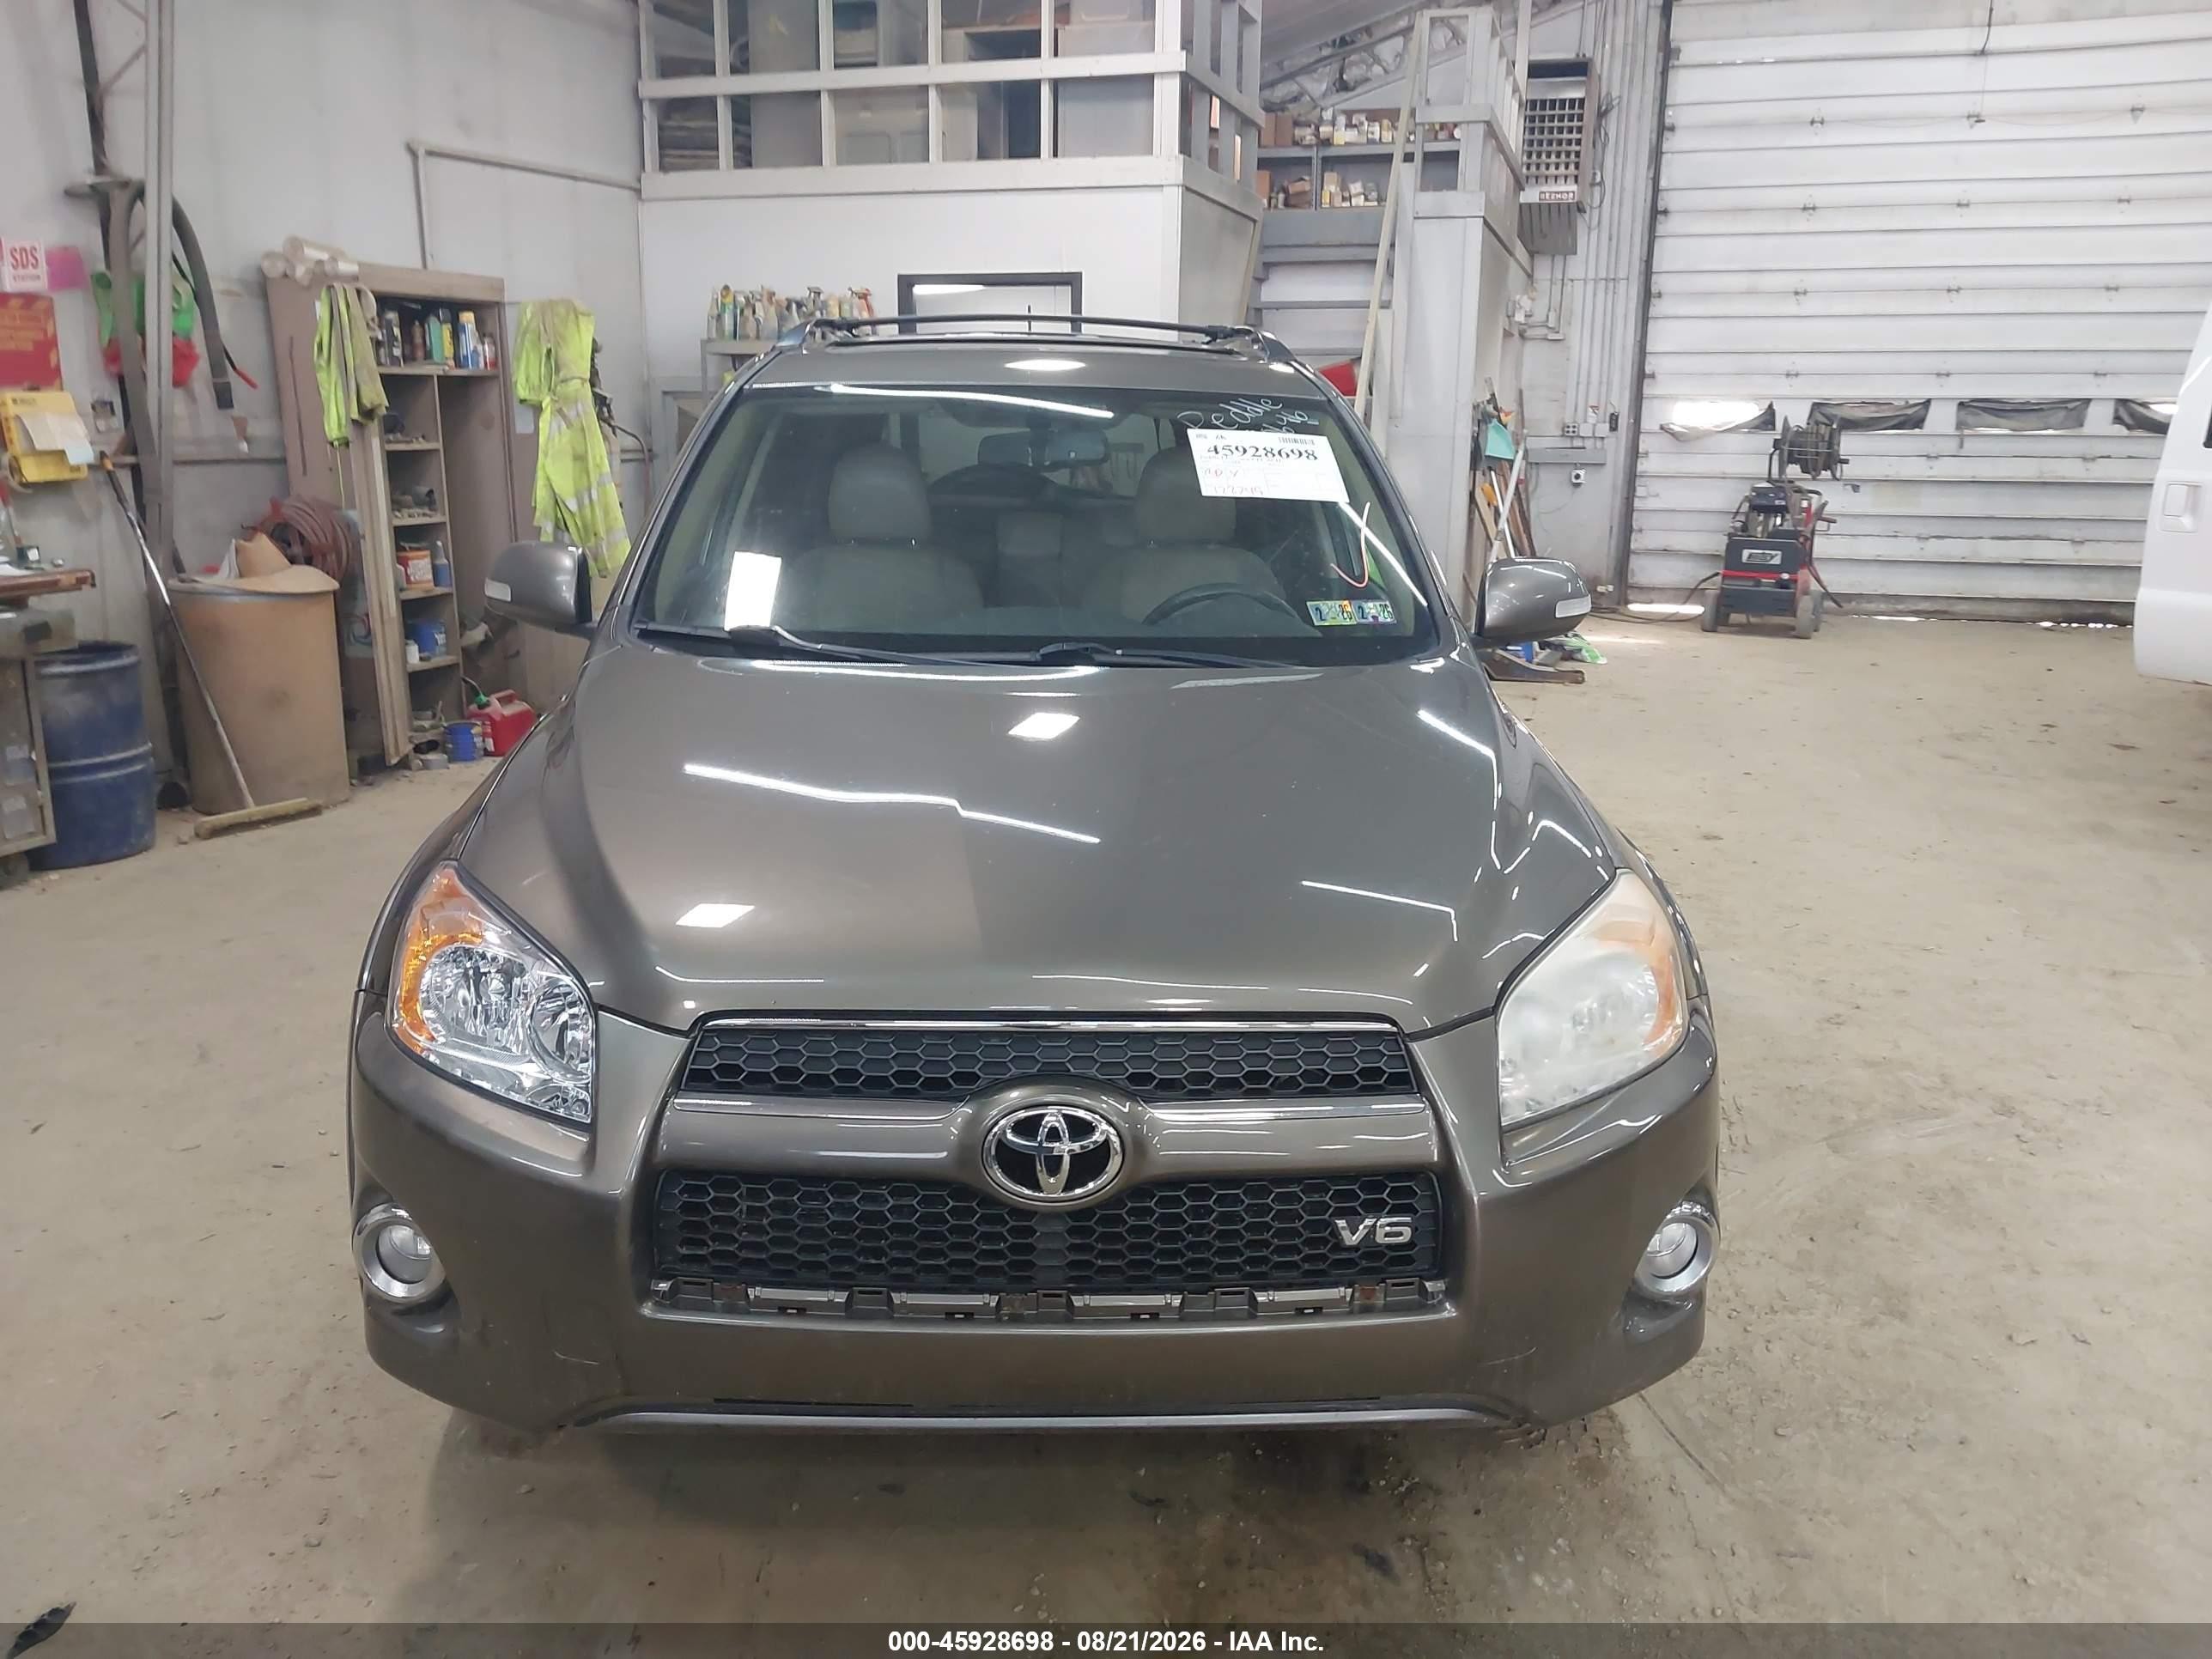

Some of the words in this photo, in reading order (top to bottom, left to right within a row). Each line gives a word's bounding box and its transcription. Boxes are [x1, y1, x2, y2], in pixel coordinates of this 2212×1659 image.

[9, 246, 39, 270] SDS
[1207, 444, 1318, 461] 45928698
[1334, 1217, 1413, 1246] V6
